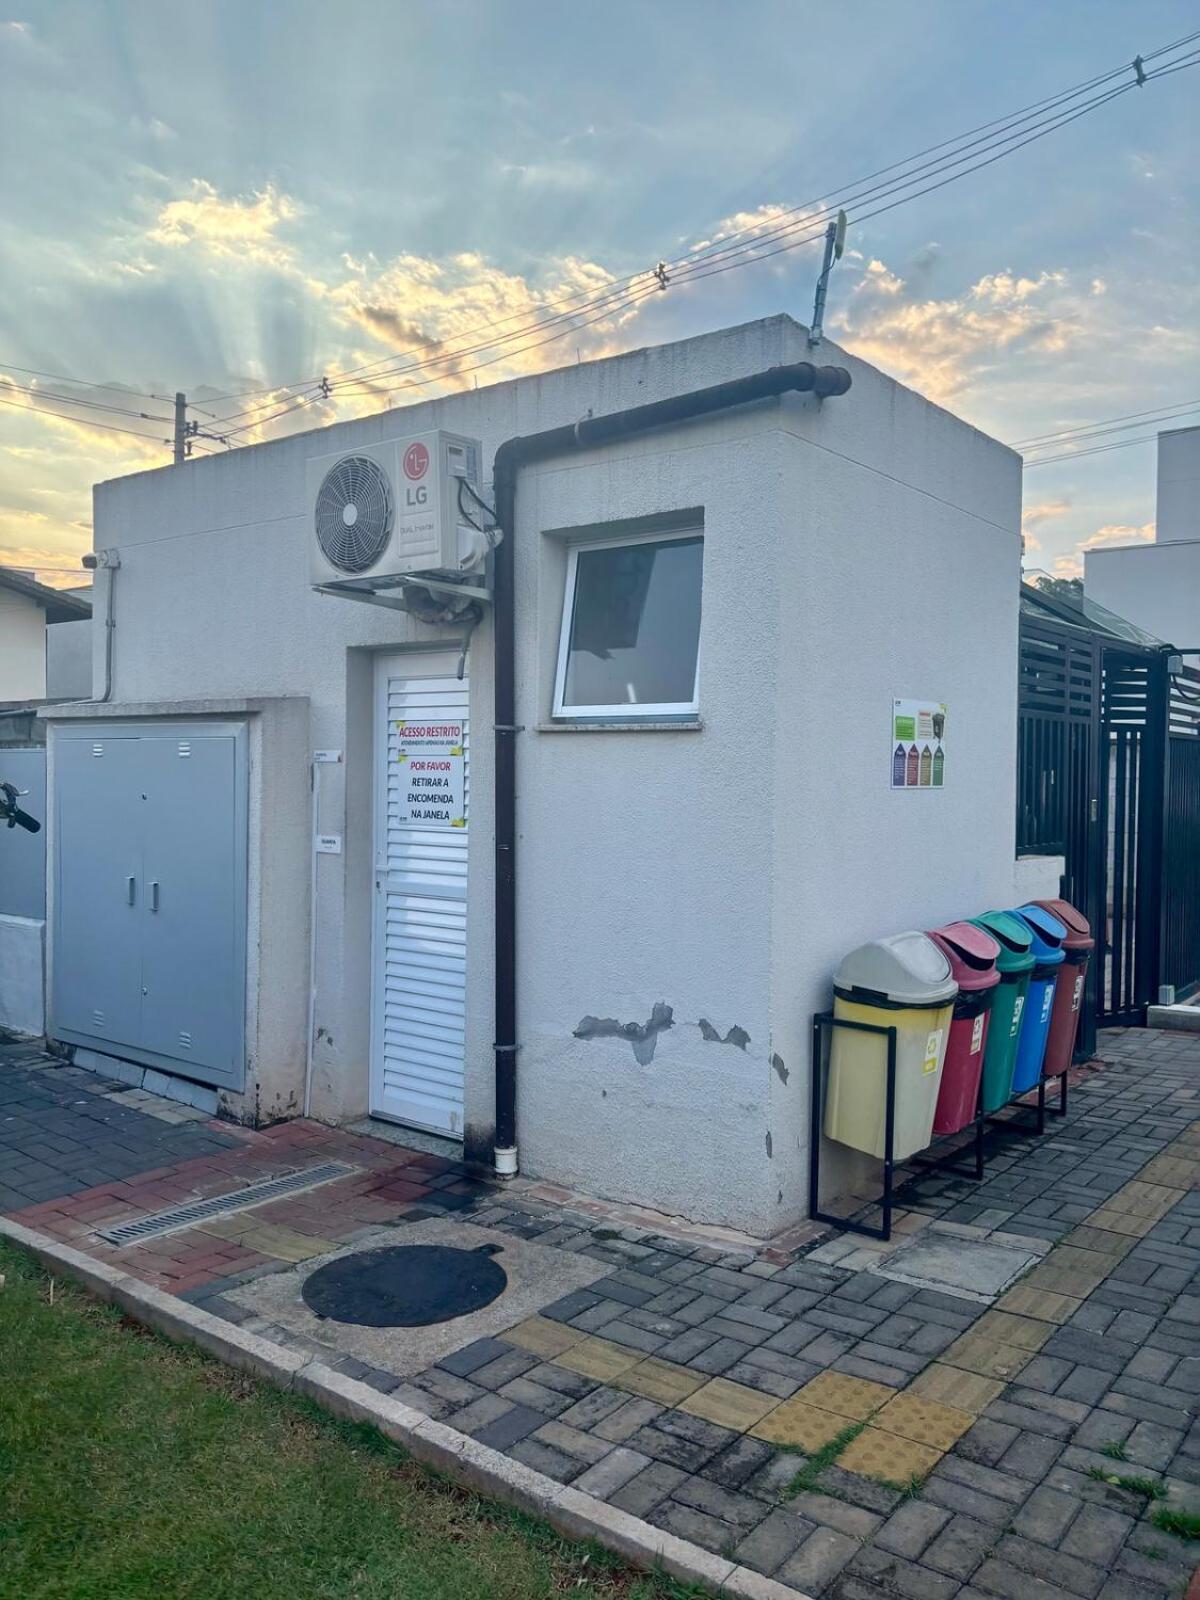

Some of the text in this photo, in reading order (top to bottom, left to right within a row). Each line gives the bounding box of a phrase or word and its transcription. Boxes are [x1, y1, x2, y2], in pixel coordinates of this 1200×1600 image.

[407, 486, 428, 506] LG
[400, 726, 460, 737] ACESSO RESTRITO
[411, 762, 451, 771] POR FAVOR
[412, 778, 449, 787] RETIRAR A
[408, 793, 454, 804] ENCOMENDA
[411, 809, 450, 820] NA JANELA
